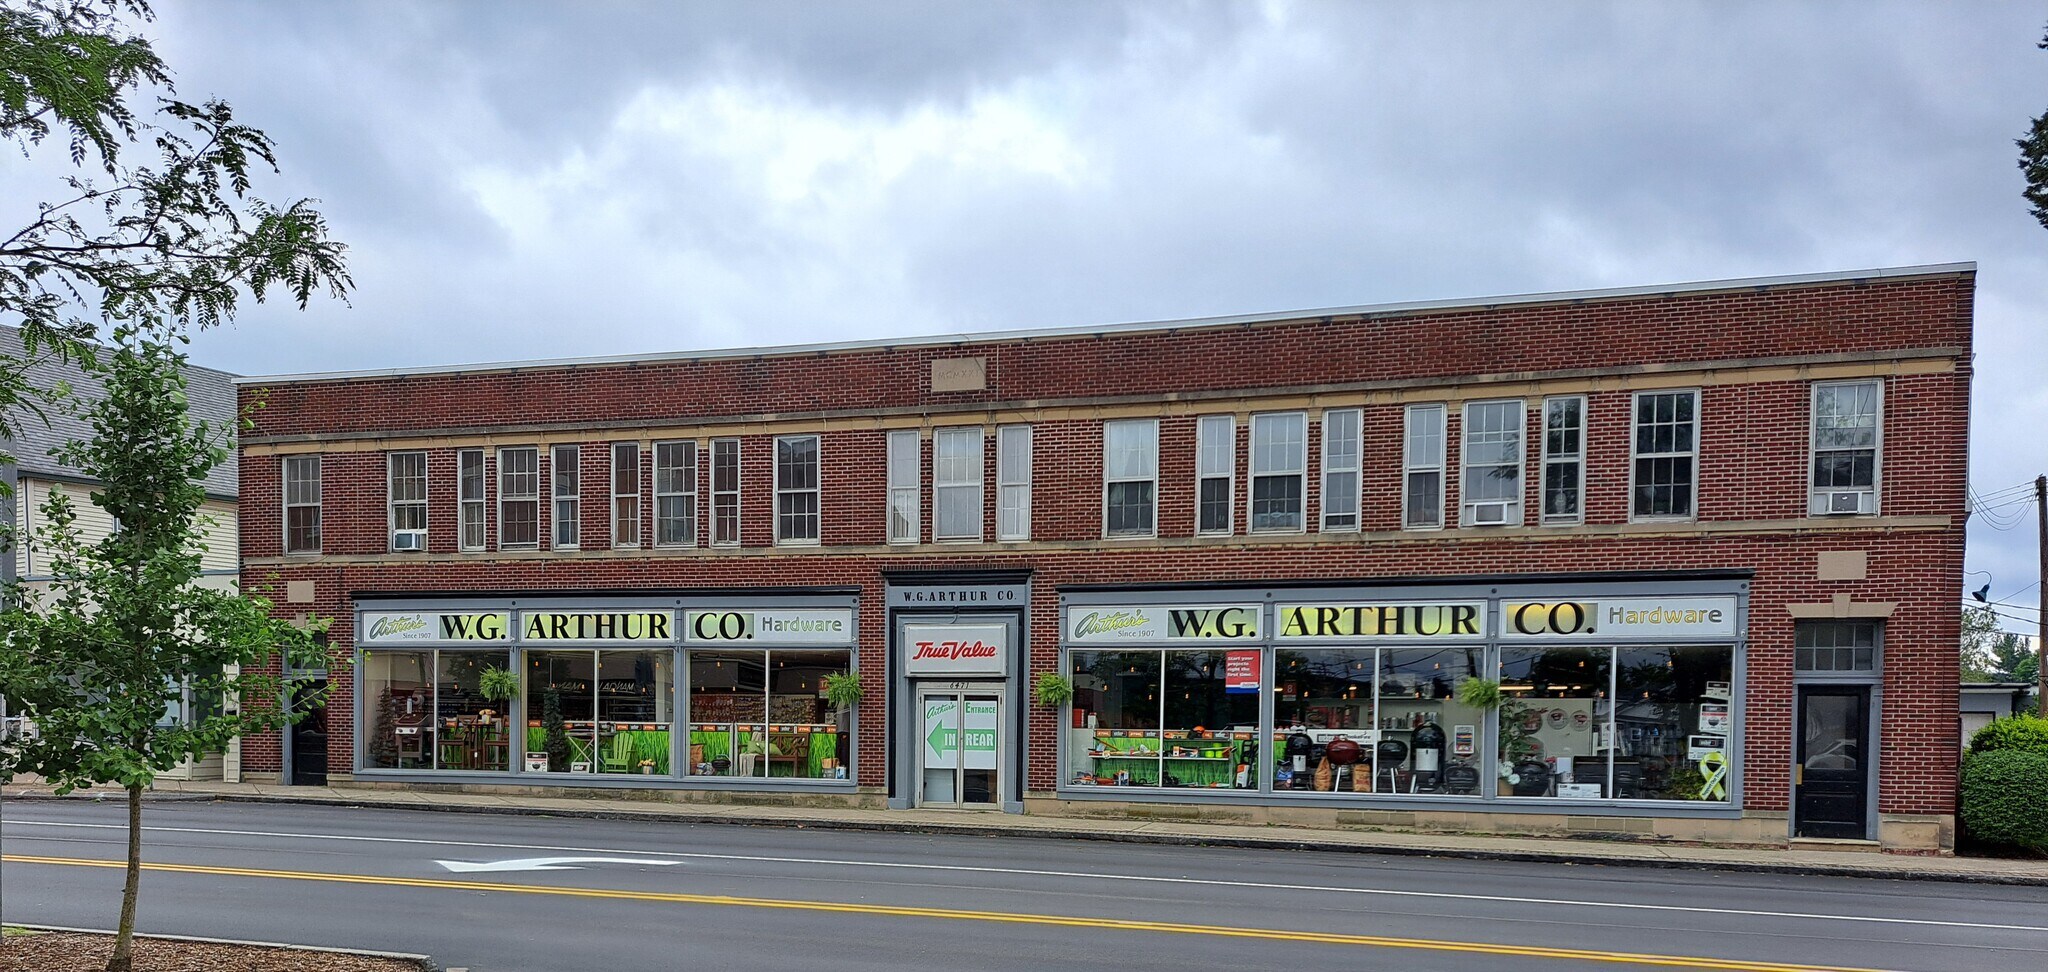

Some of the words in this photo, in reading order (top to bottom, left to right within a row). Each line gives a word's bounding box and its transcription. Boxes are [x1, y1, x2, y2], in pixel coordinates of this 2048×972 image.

[997, 590, 1017, 600] CO.
[762, 616, 842, 632] Hardware
[1074, 609, 1150, 639] Arthur's
[1170, 607, 1256, 638] W.G.
[1280, 605, 1479, 637] ARTHUR
[1514, 602, 1595, 635] CO.
[1609, 606, 1723, 624] Hardware
[369, 614, 427, 640] Arthur's
[440, 613, 506, 640] W.G.
[526, 613, 670, 639] ARTHUR
[694, 612, 753, 640] CO.
[927, 702, 956, 719] Arthur's
[944, 733, 956, 746] IN
[966, 733, 994, 747] REAR
